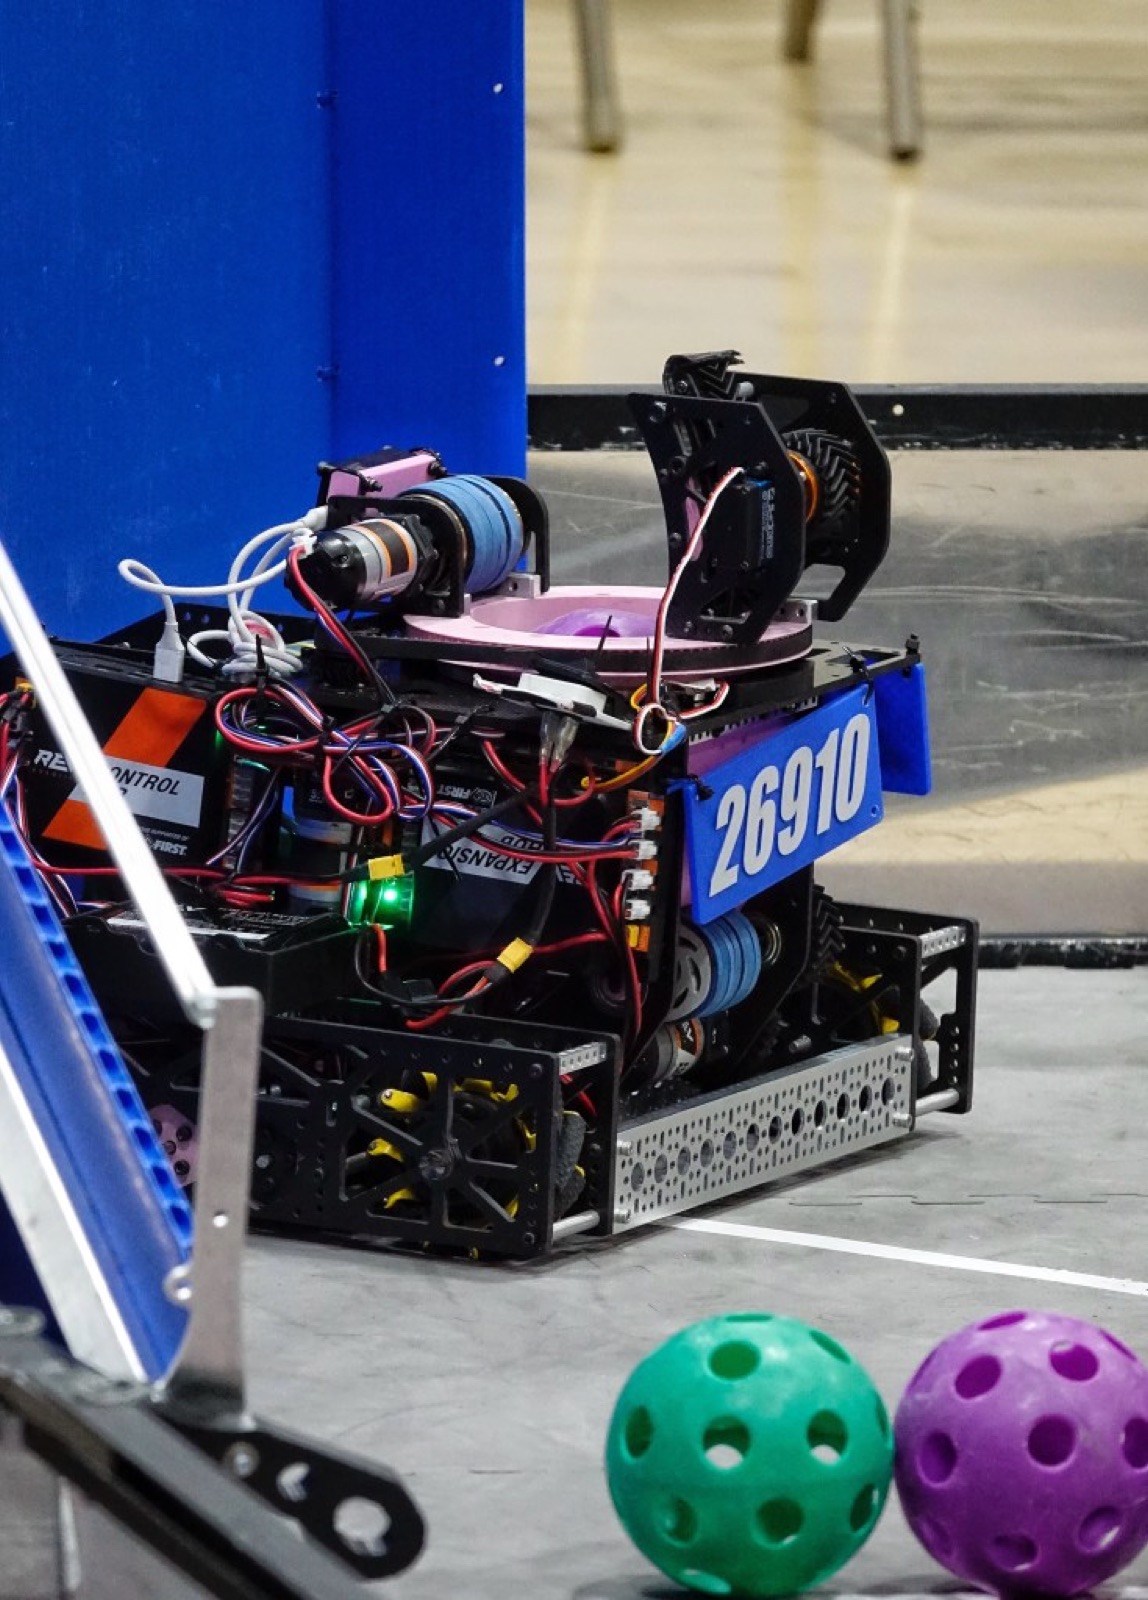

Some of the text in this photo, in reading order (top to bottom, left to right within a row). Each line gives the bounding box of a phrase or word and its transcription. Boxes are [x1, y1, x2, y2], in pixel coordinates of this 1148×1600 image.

[33, 749, 69, 774] RE
[110, 766, 181, 796] ONTROL
[709, 713, 871, 897] 26910
